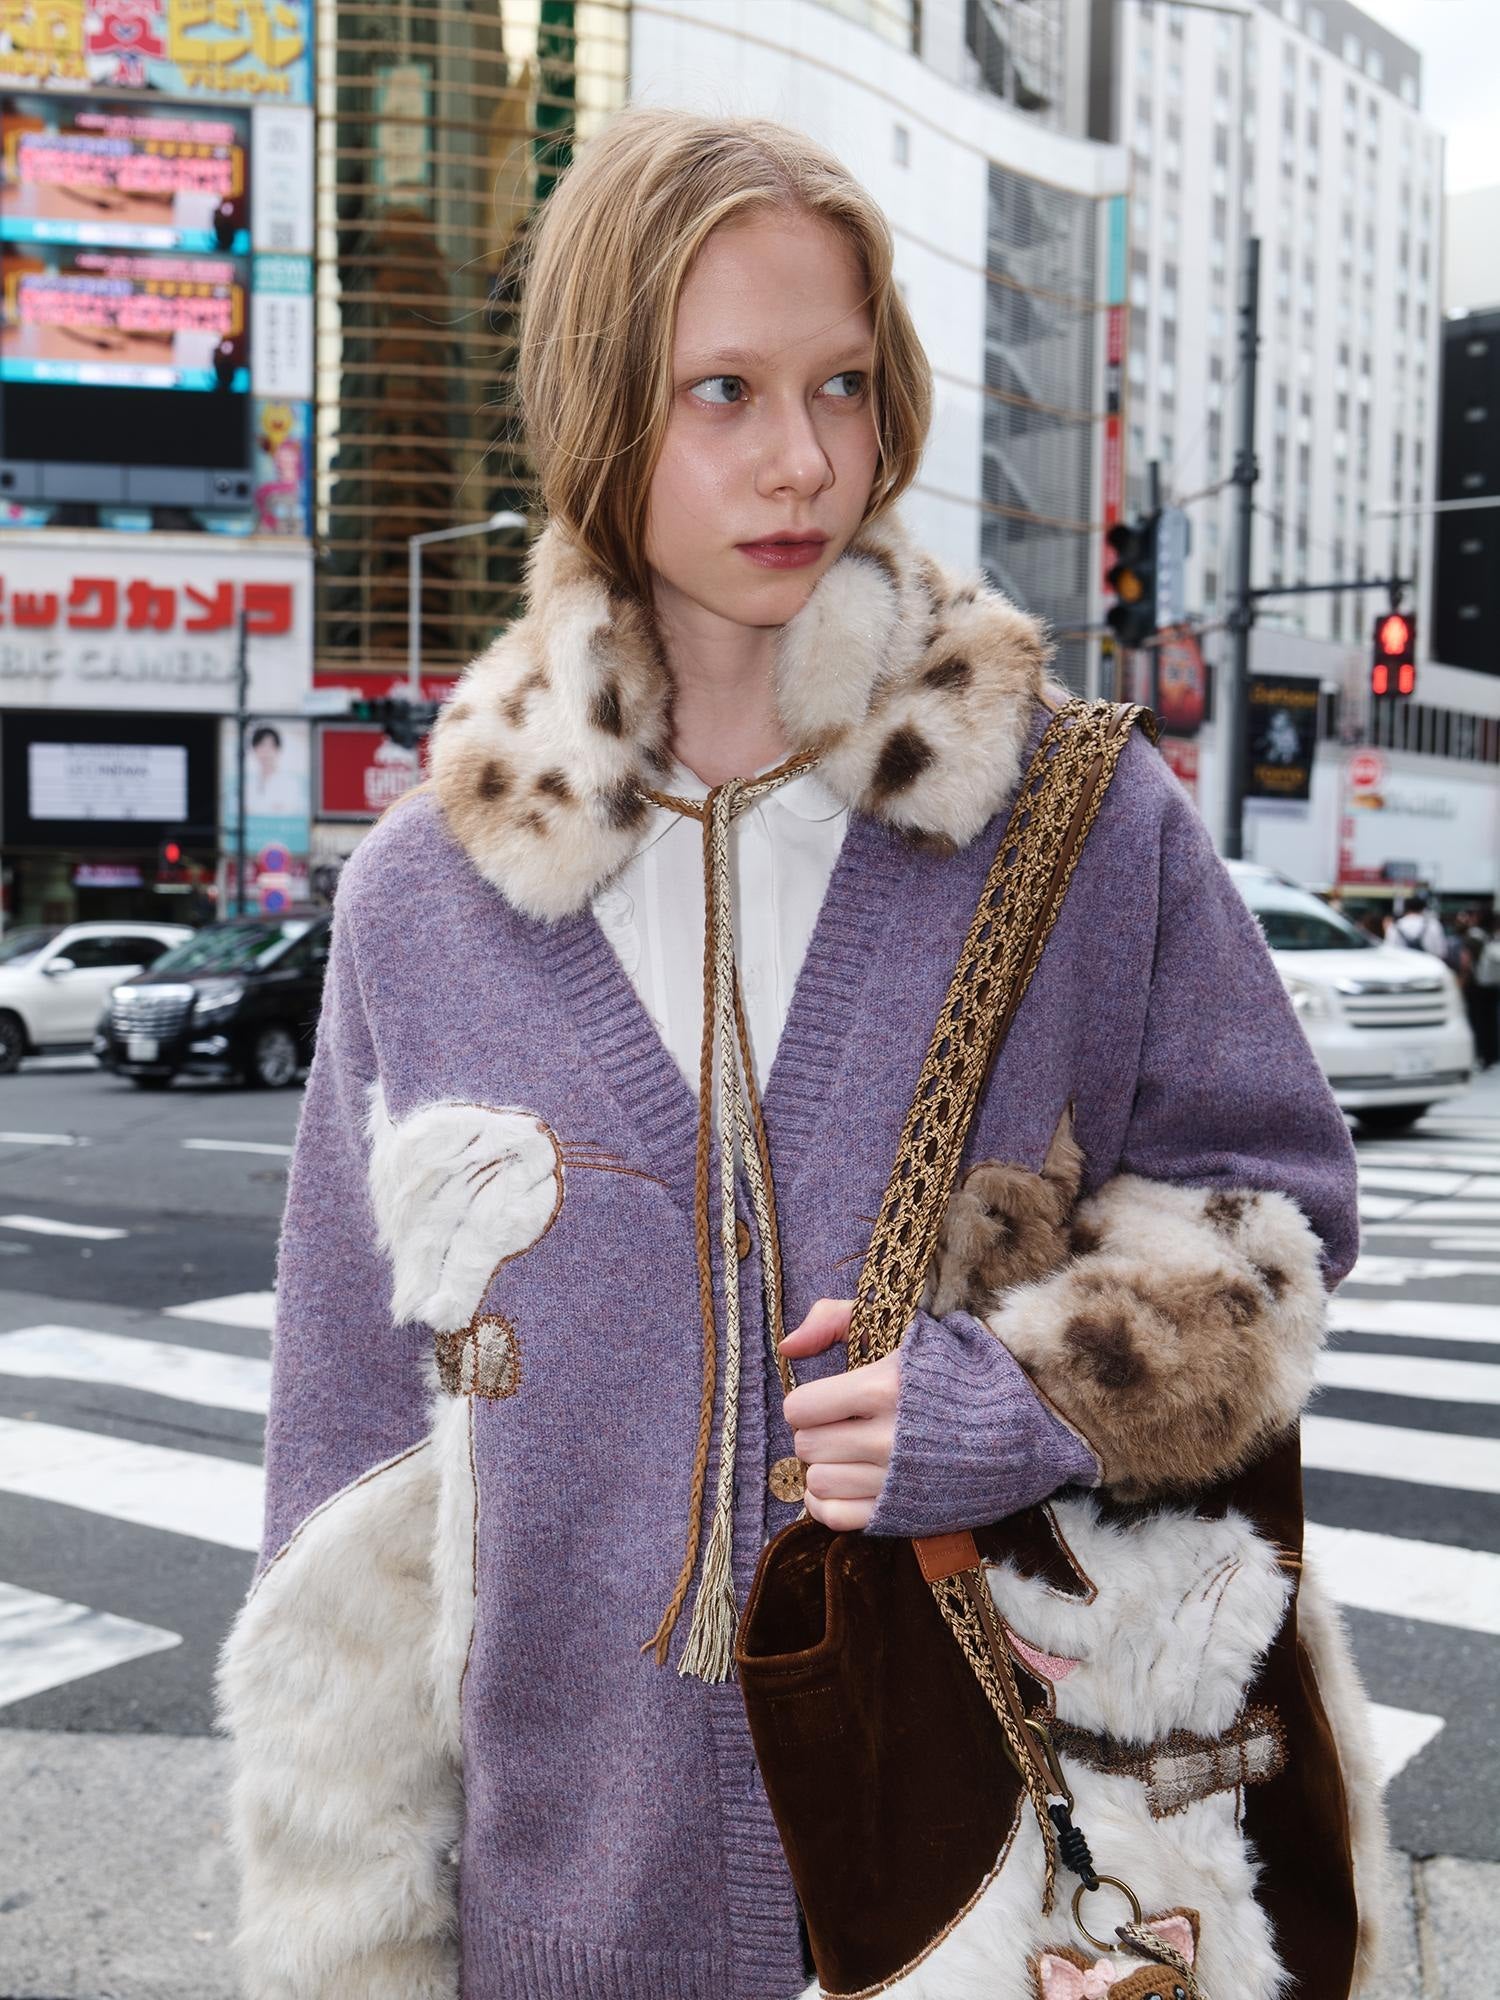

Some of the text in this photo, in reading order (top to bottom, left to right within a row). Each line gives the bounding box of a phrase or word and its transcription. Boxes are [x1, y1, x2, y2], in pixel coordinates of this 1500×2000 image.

[0, 575, 293, 635] ックカメラ
